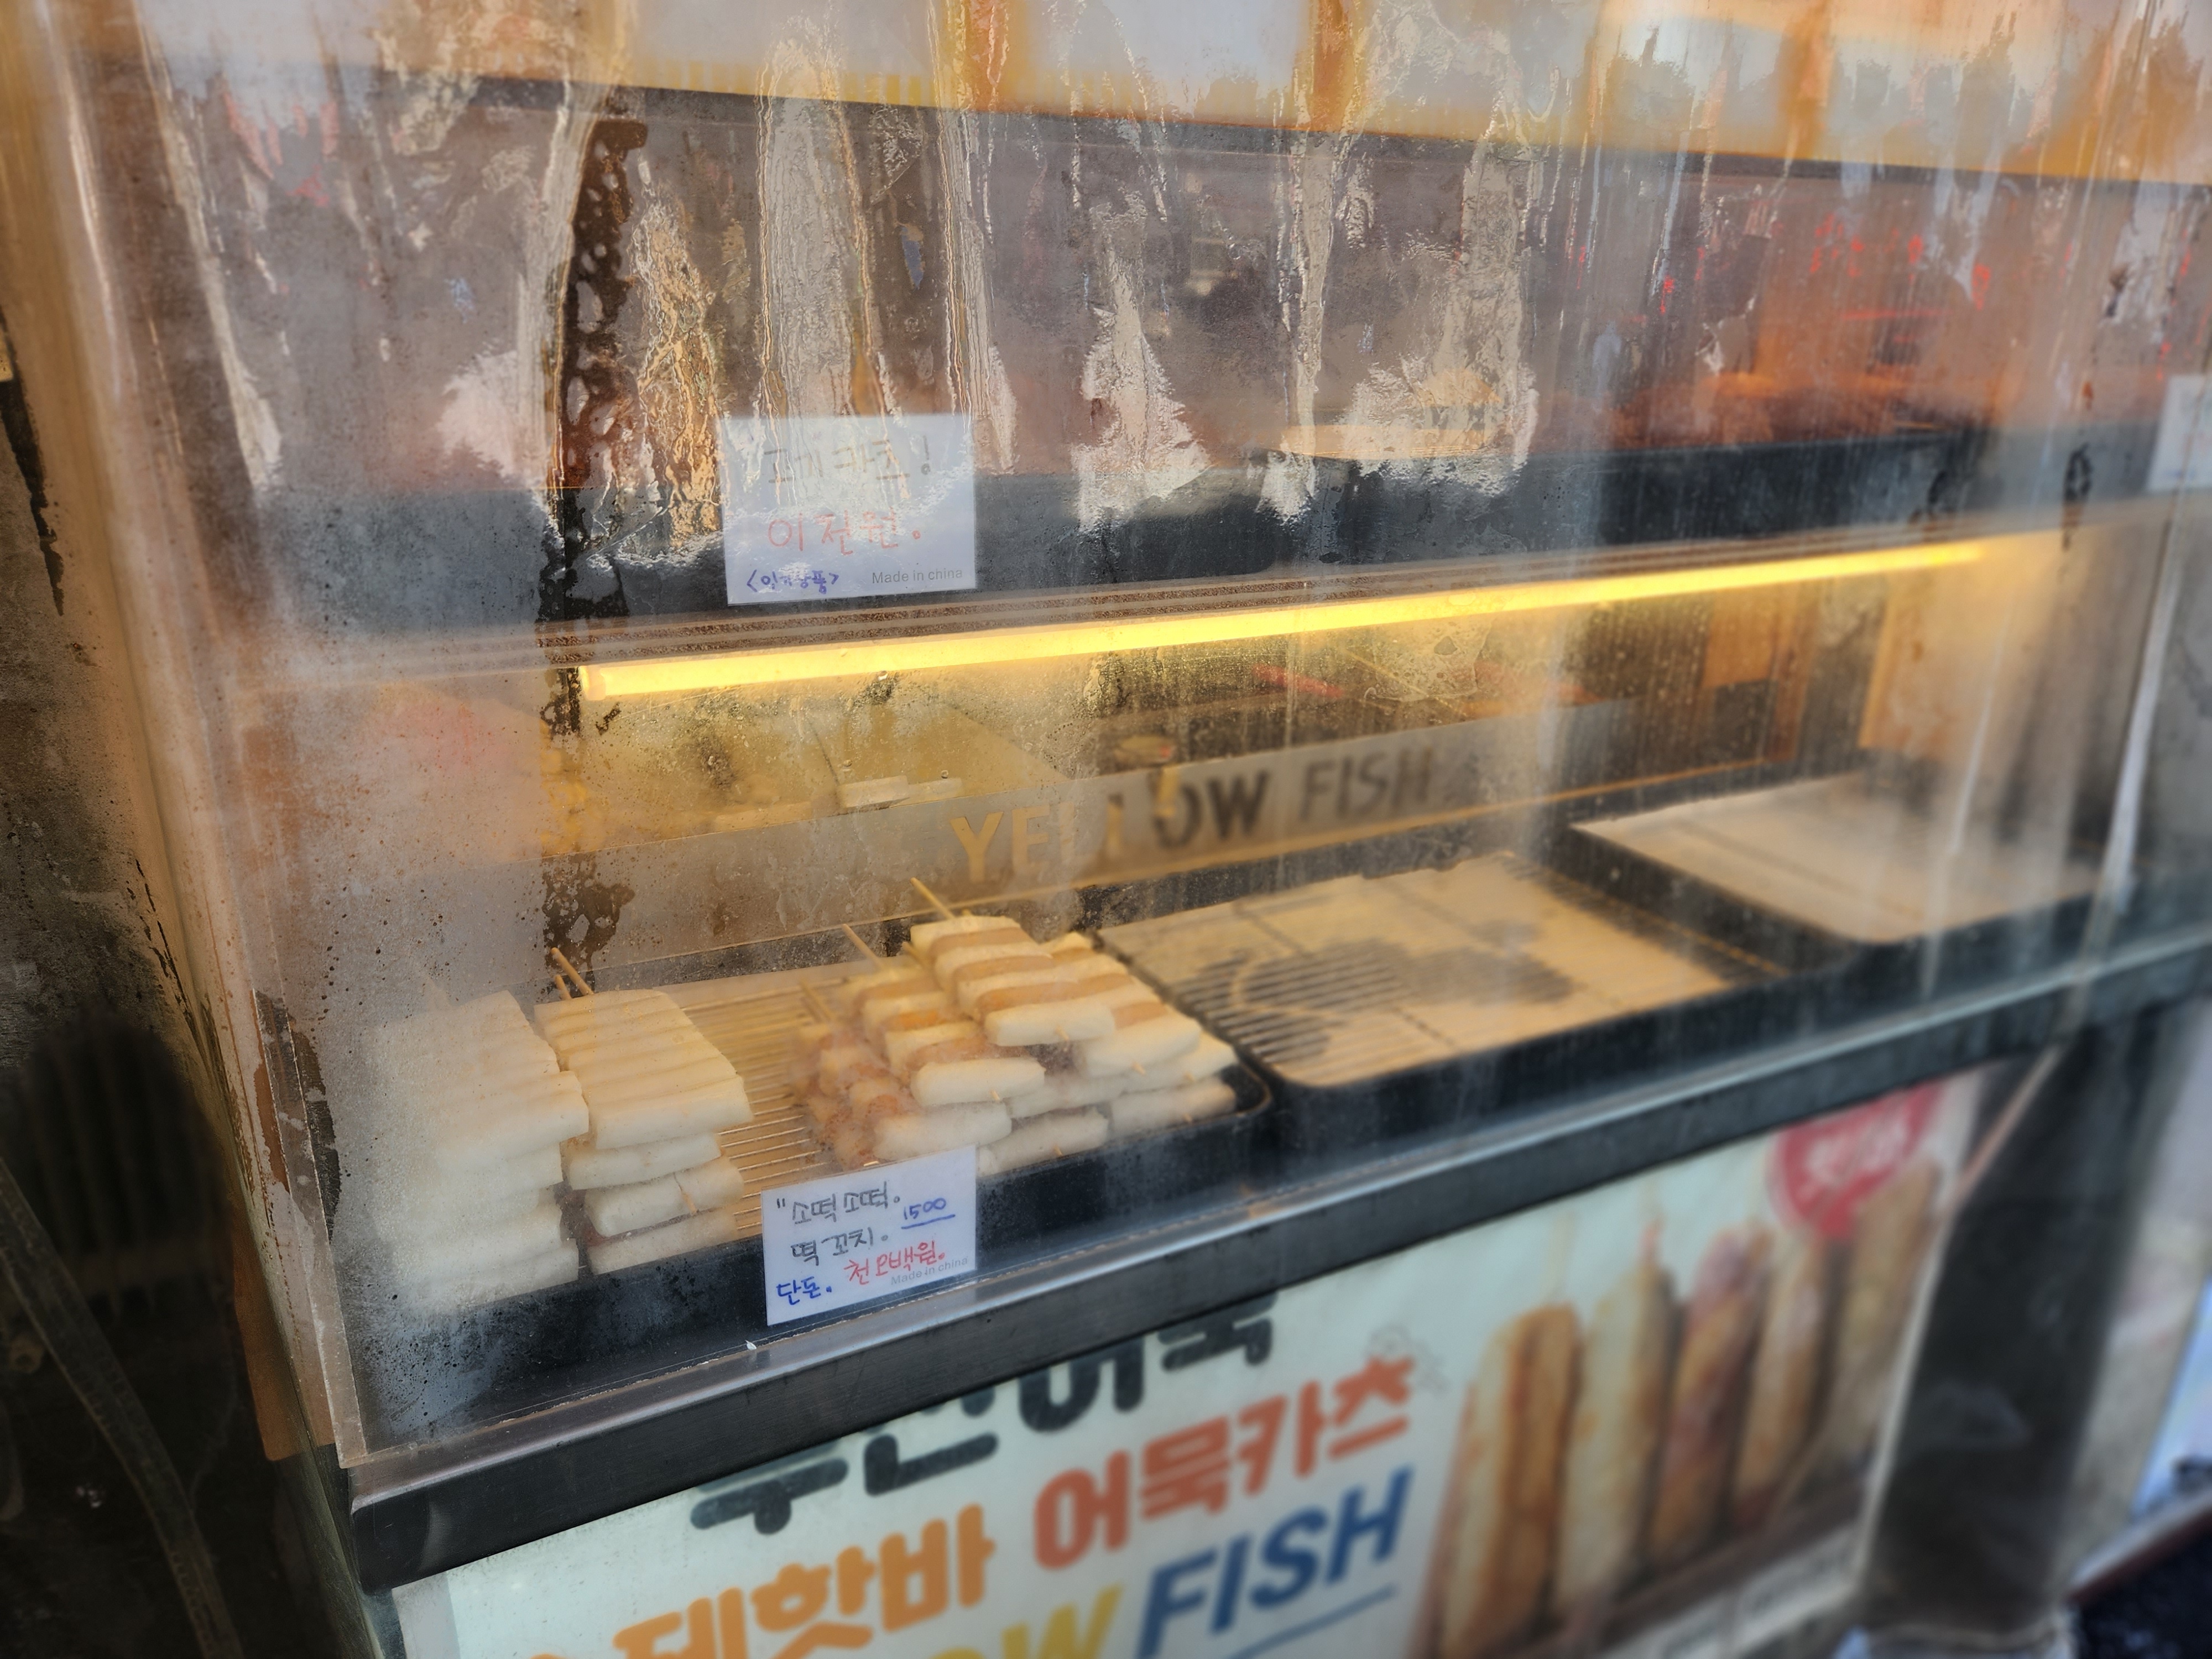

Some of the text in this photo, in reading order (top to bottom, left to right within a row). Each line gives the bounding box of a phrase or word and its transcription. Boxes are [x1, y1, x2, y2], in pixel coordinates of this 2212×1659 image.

[872, 568, 963, 585] Made in china
[1297, 745, 1433, 825] FISH
[903, 1197, 947, 1220] 1500
[891, 1256, 968, 1285] Made in china
[1034, 1355, 1413, 1572] 어묵카츠
[1136, 1463, 1415, 1659] FISH
